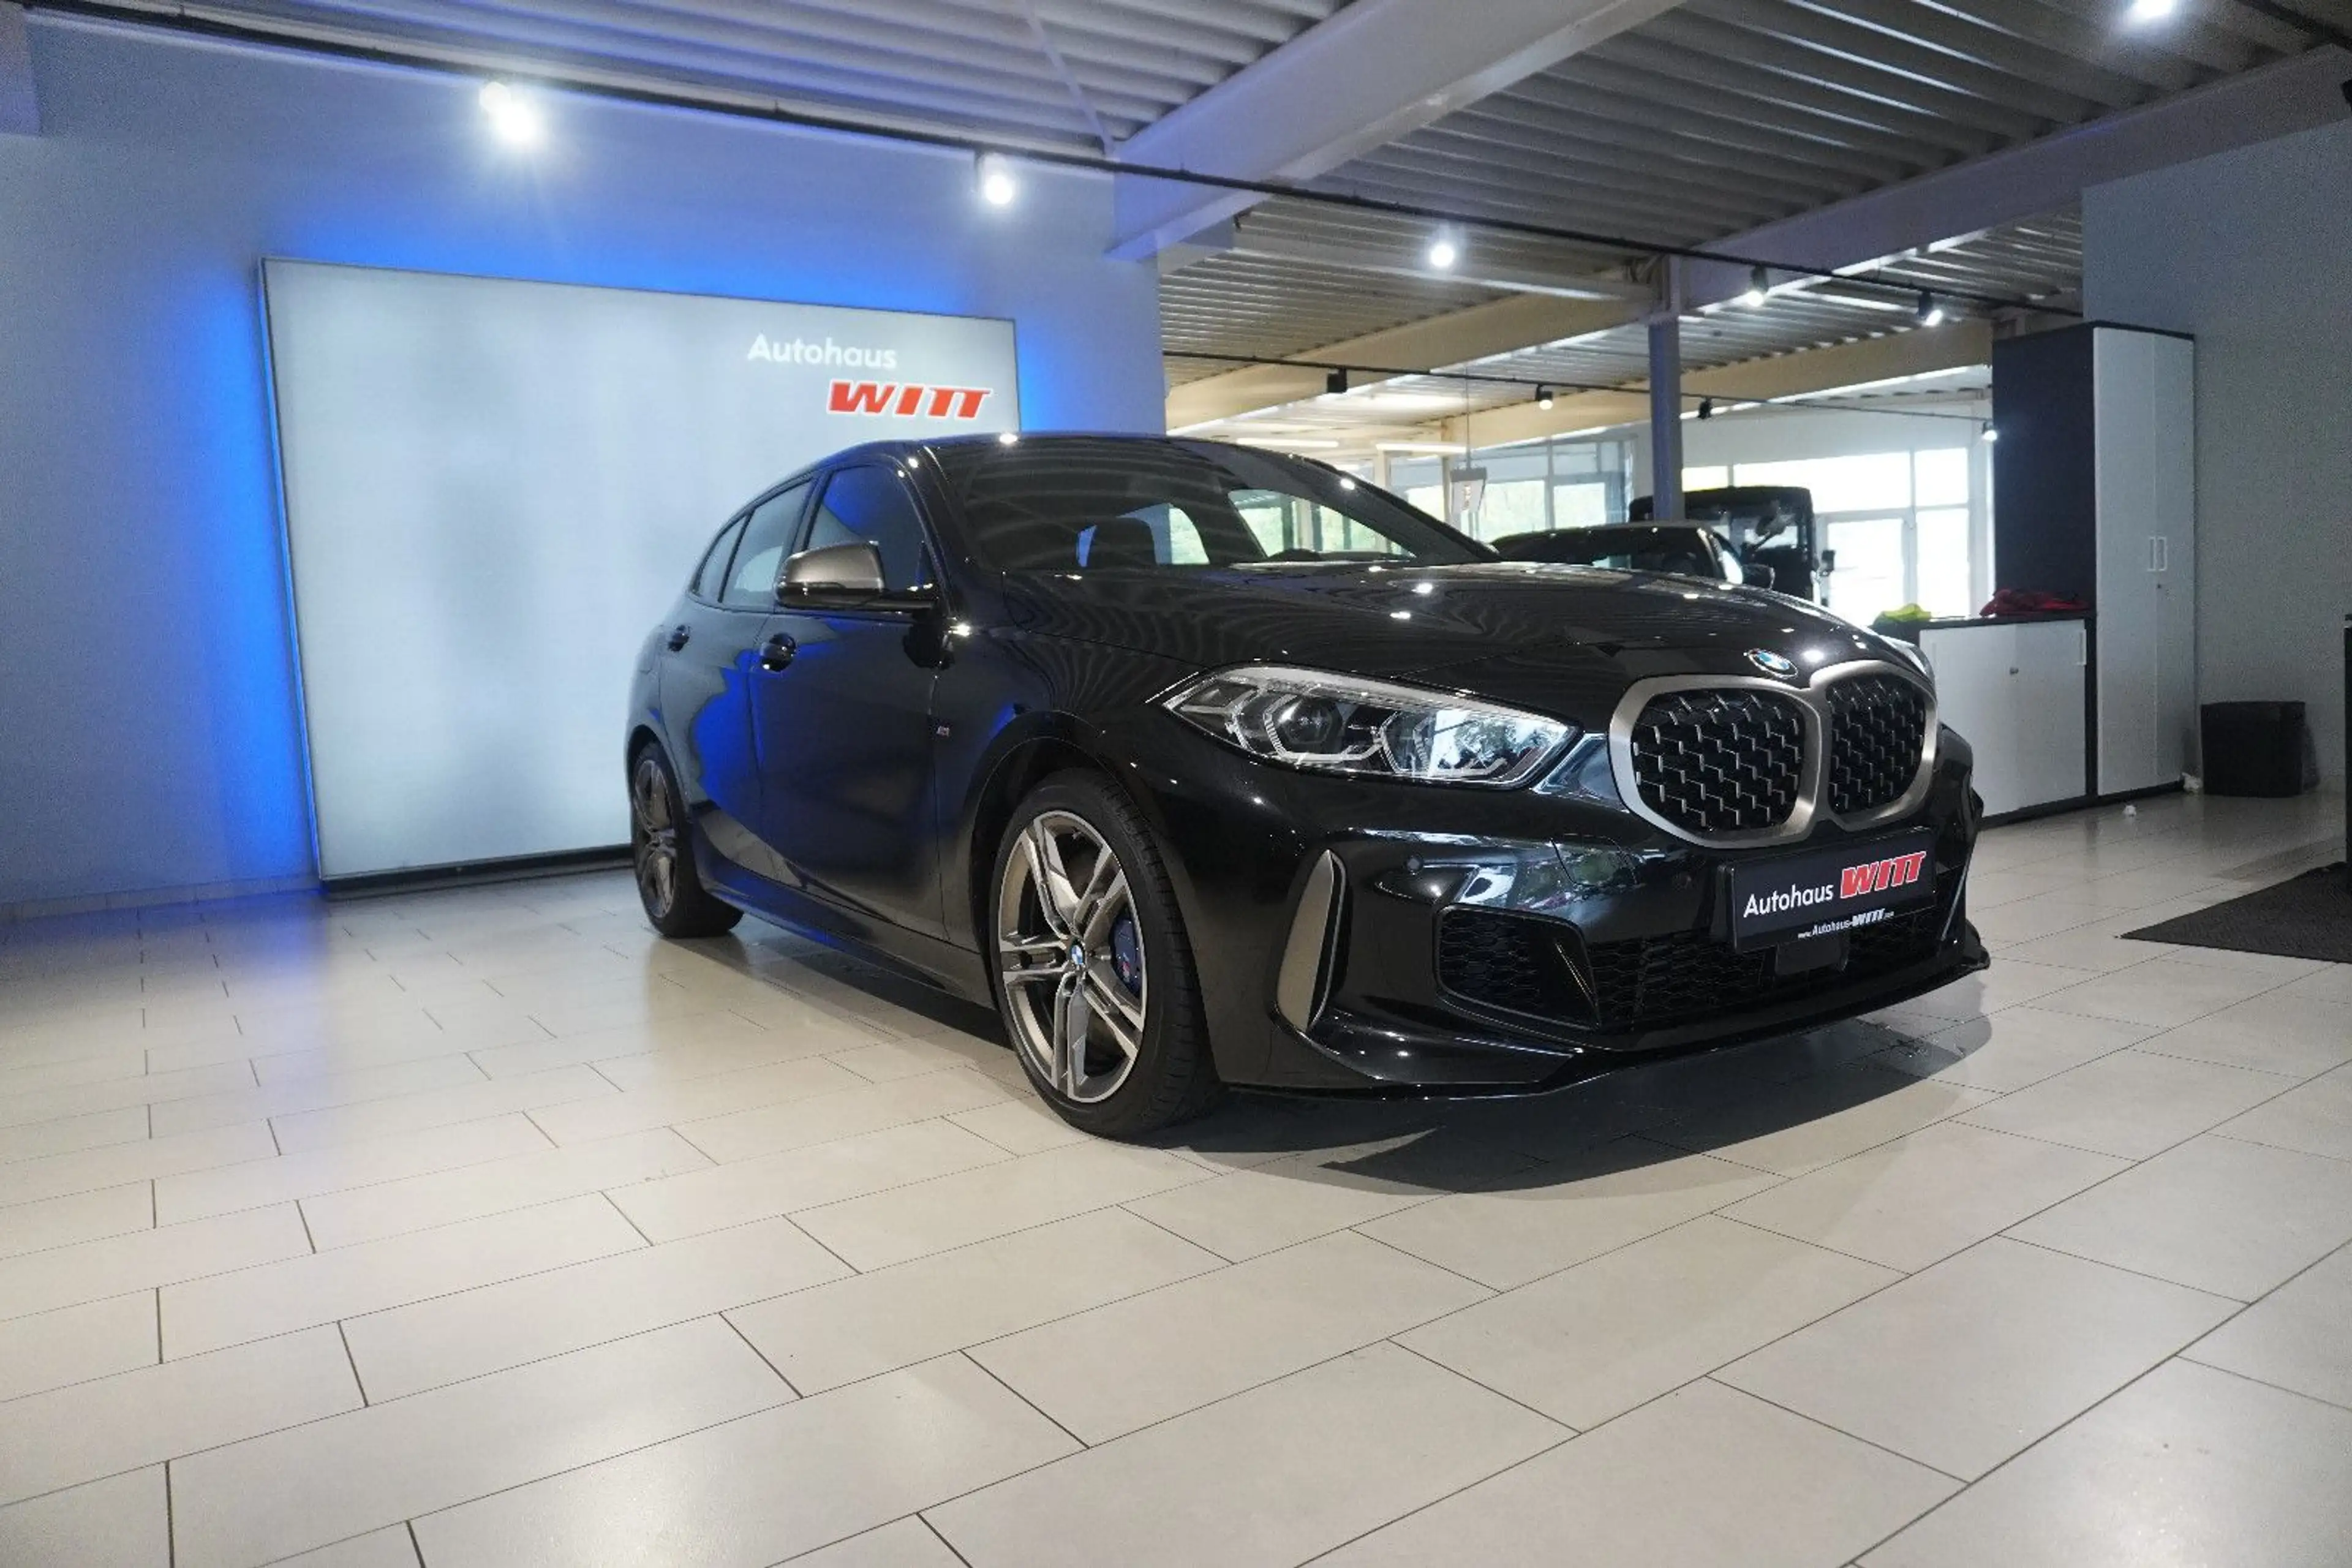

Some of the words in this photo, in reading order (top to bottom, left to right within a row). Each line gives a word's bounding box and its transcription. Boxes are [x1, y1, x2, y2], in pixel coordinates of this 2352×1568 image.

[747, 333, 897, 368] Autohaus
[827, 379, 992, 419] WITT
[1743, 883, 1834, 918] Autohaus
[1839, 851, 1926, 899] WITT
